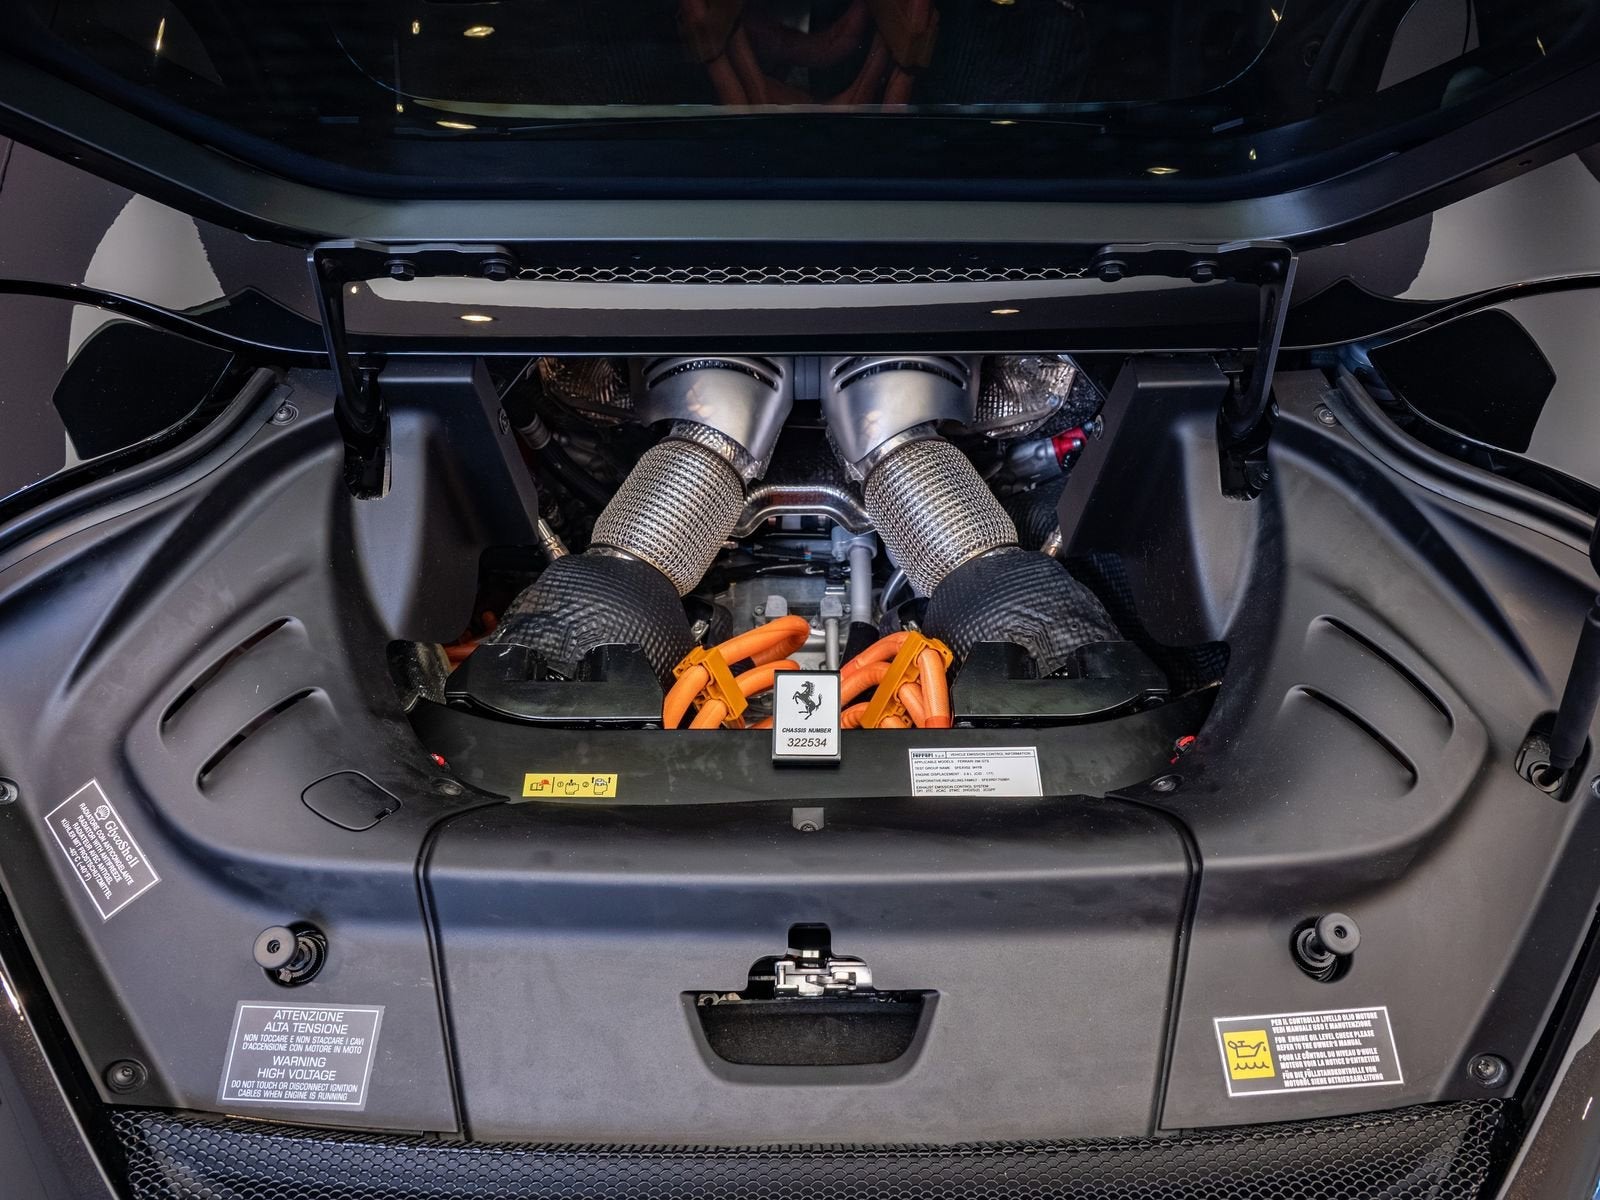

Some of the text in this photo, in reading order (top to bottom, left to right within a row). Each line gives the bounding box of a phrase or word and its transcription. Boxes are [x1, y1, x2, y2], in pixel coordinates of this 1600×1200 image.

[787, 738, 827, 747] 322534
[72, 837, 81, 848] MIT
[77, 814, 123, 883] RADIATOR WITH ANTIFREEZE
[80, 802, 134, 885] RADIATORE CON ANTICONGELANTE
[104, 820, 140, 868] GlycoShell
[72, 822, 113, 885] RADIATEUR AVEC ANTIGEL
[274, 1010, 344, 1022] ATTENZIONE
[1288, 1016, 1320, 1024] CONTROLLO
[264, 1022, 348, 1034] ALTA TENSIONE
[1286, 1024, 1312, 1032] MANUALE
[261, 1034, 288, 1042] TOCCARE
[296, 1036, 310, 1044] NON
[312, 1036, 344, 1044] STACCARE
[350, 1038, 364, 1046] CAVI
[242, 1042, 288, 1051] D'ACCENSIONE
[305, 1044, 332, 1052] MOTORE
[343, 1046, 362, 1054] MOTO
[273, 1056, 326, 1067] WARNING
[1280, 1061, 1304, 1069] MOTEUR
[257, 1068, 336, 1080] HIGH VOLTAGE
[231, 1080, 241, 1088] DO
[256, 1081, 278, 1089] TOUCH
[279, 1082, 288, 1090] OR
[289, 1082, 329, 1091] DISCONNECT
[330, 1084, 358, 1092] IGNITION
[264, 1090, 282, 1098] WHEN
[284, 1091, 307, 1099] ENGINE
[318, 1092, 348, 1100] RUNNING
